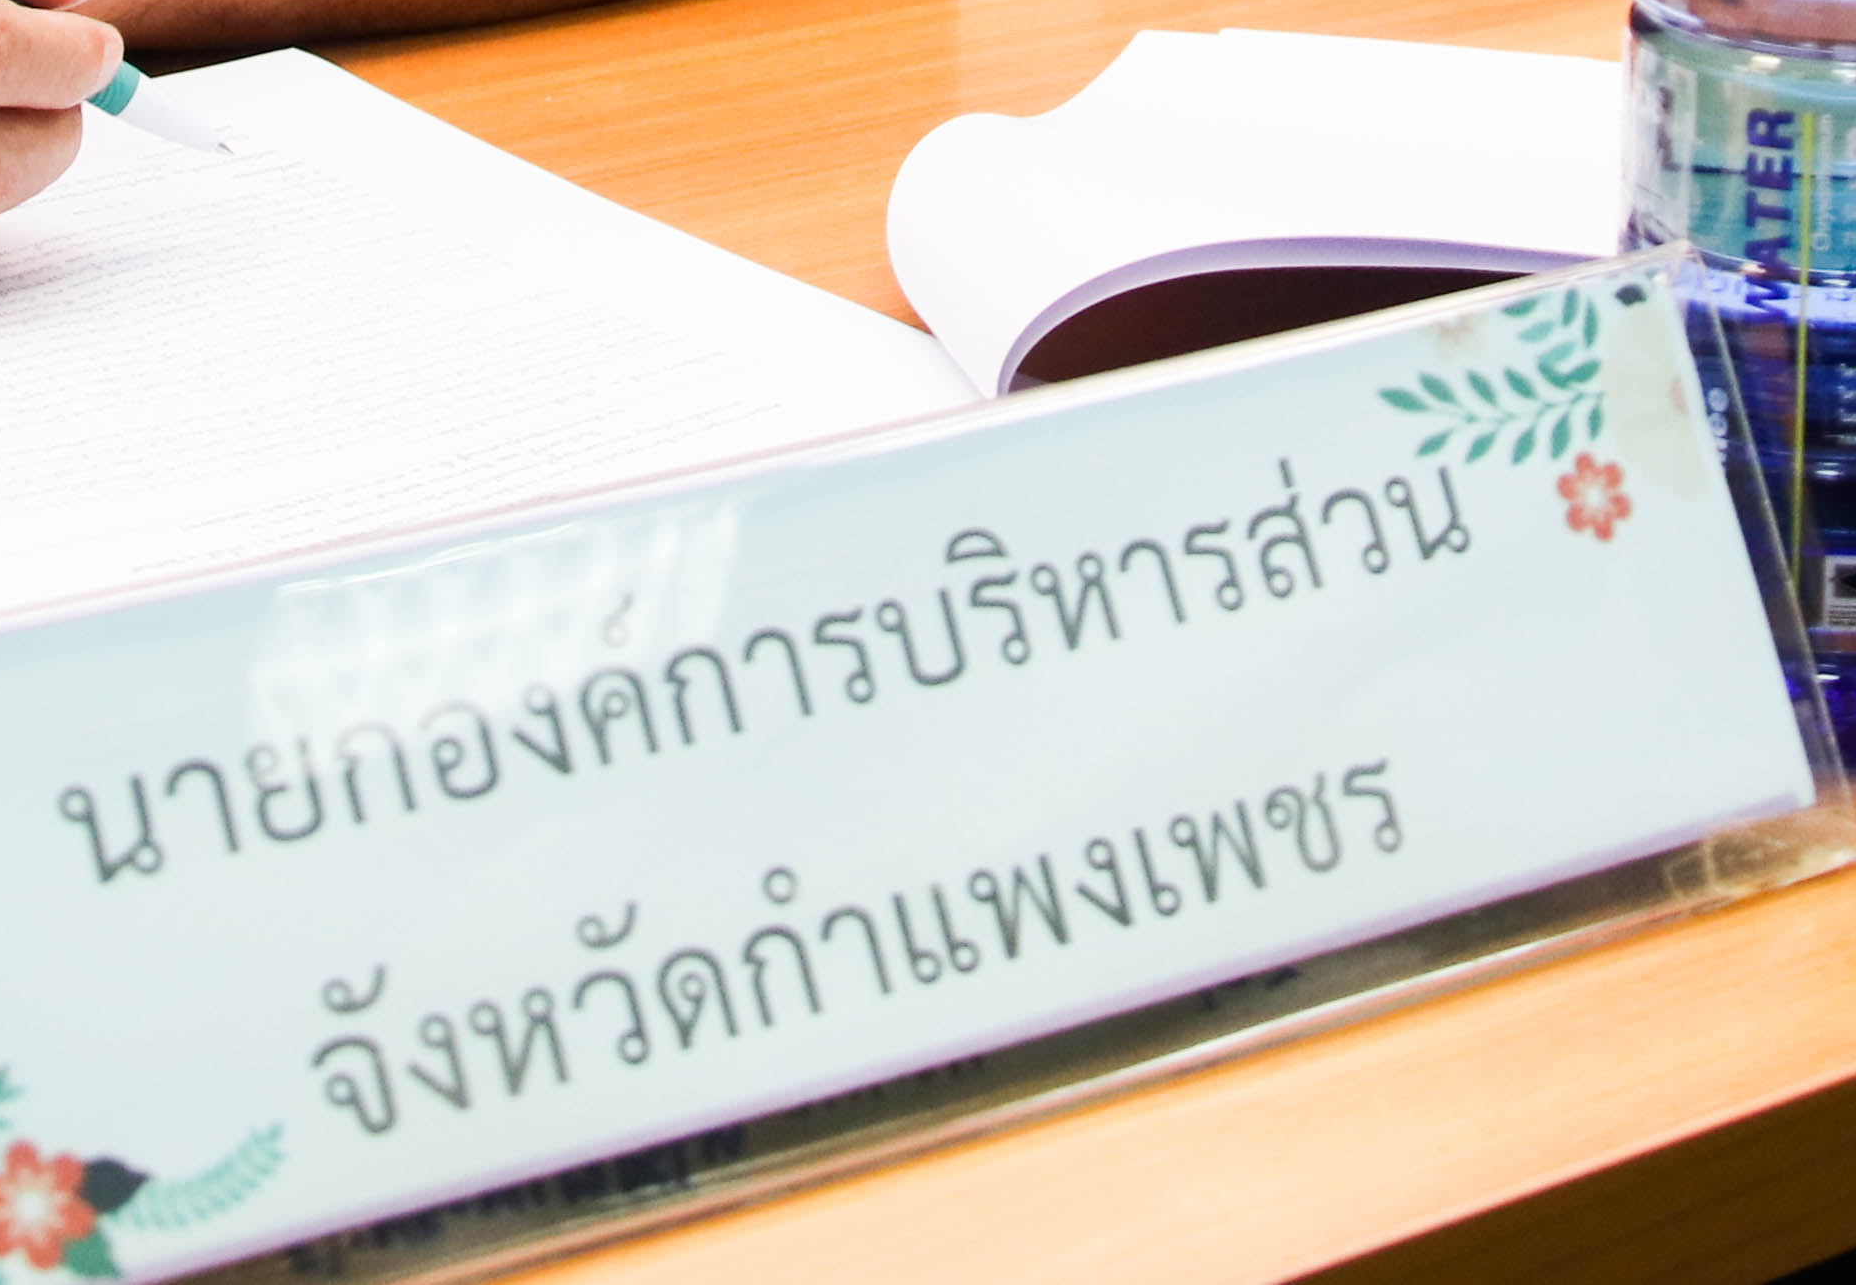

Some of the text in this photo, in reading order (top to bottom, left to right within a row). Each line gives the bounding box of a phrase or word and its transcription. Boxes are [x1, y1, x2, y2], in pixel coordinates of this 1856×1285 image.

[1744, 107, 1795, 324] WATER
[56, 456, 1472, 885] นายกองค์การบริหารส่วน
[310, 759, 1405, 1134] จังหวัดกำแพงเพชร
